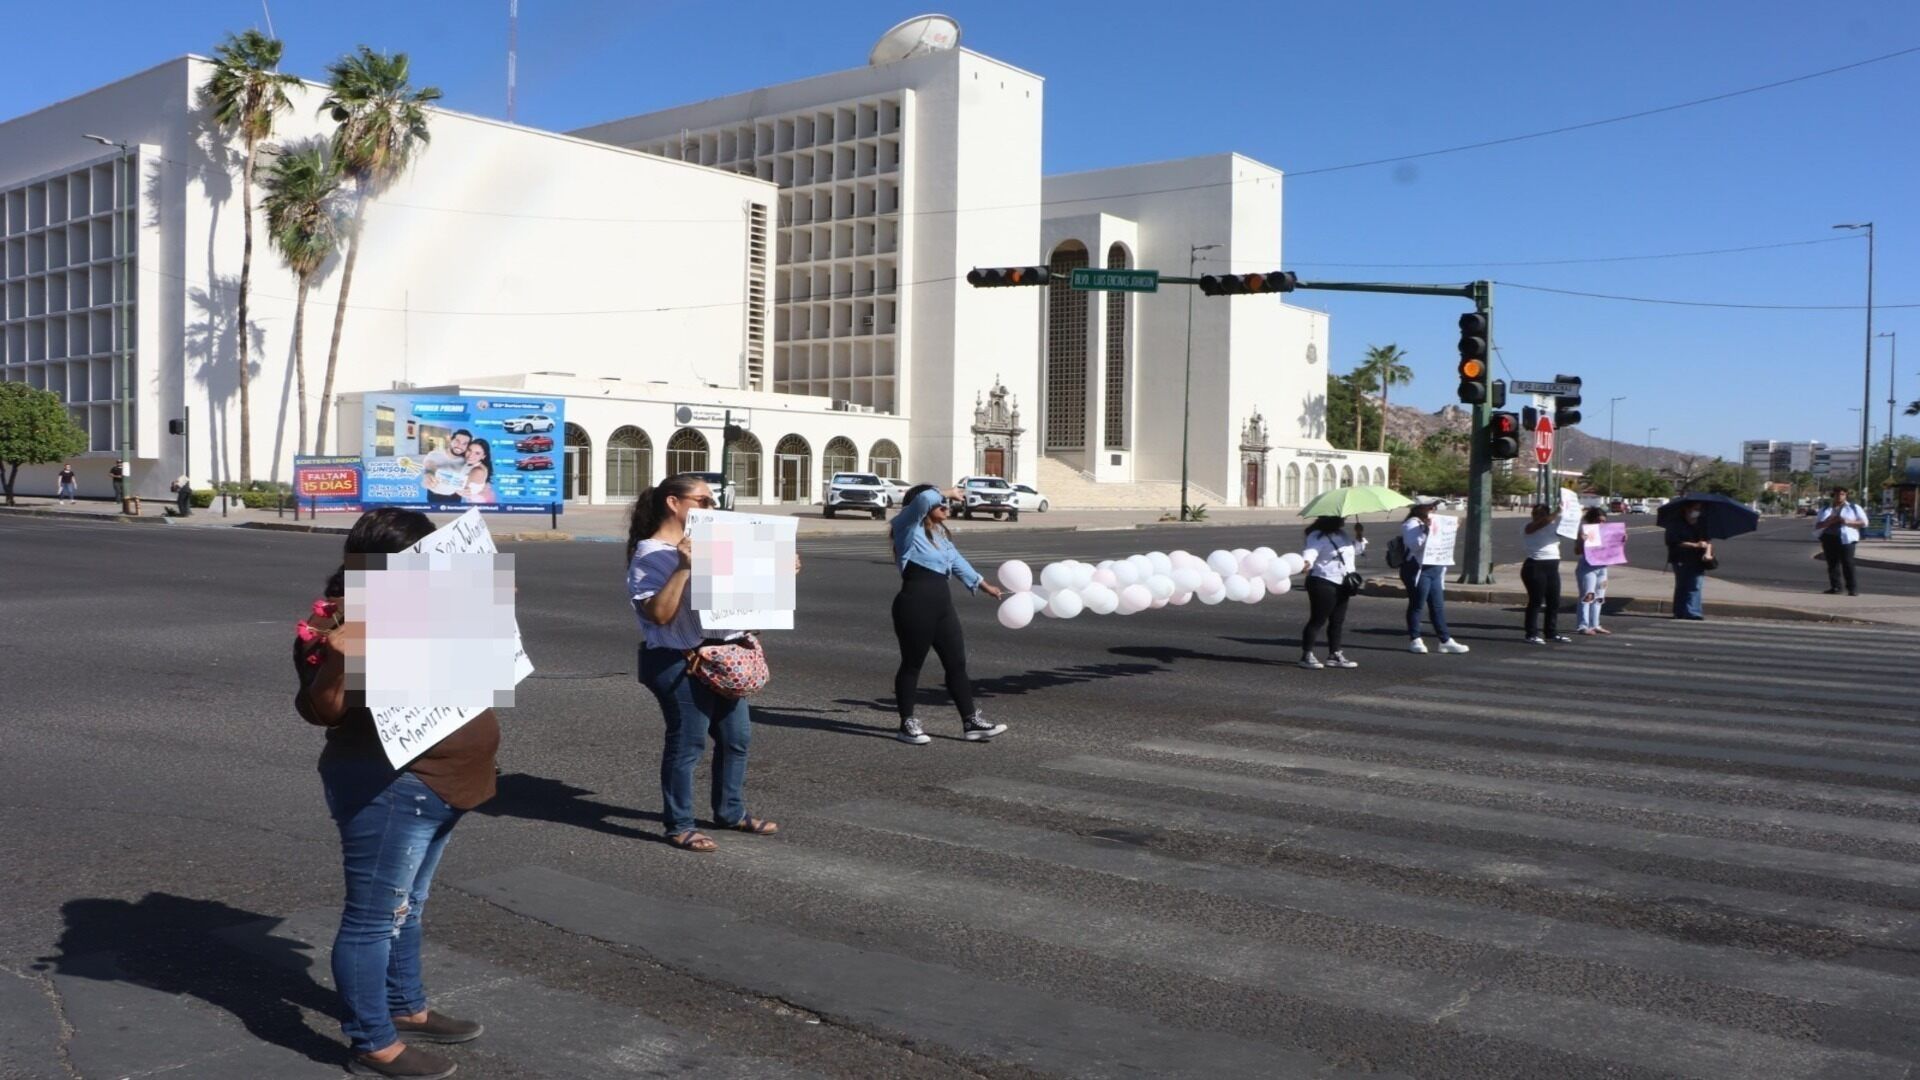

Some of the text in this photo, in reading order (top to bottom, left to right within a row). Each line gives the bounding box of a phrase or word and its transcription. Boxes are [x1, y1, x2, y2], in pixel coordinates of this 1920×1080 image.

[1537, 431, 1552, 450] ALTO
[307, 472, 348, 481] FALTAN
[304, 482, 318, 491] 15
[381, 721, 401, 743] QUE
